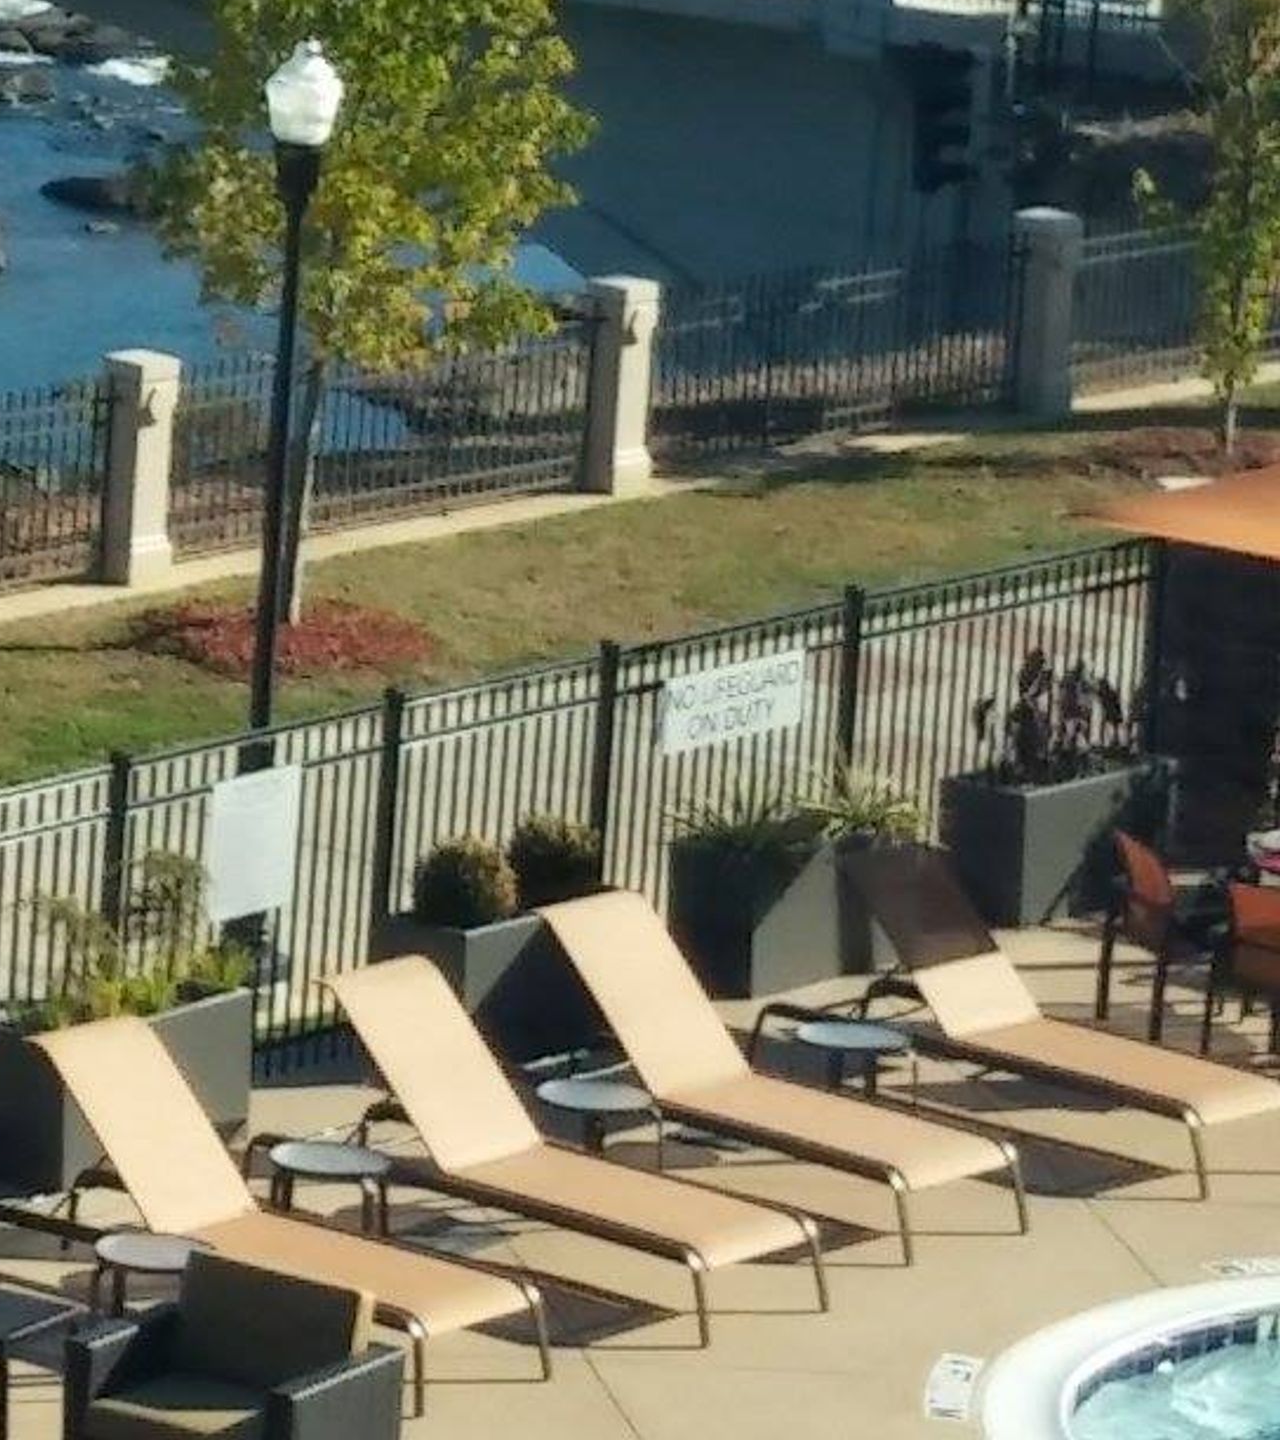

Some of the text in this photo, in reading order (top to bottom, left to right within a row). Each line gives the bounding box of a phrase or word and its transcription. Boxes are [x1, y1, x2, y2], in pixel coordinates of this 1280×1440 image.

[667, 684, 696, 710] NO
[687, 697, 775, 740] ON DUTY
